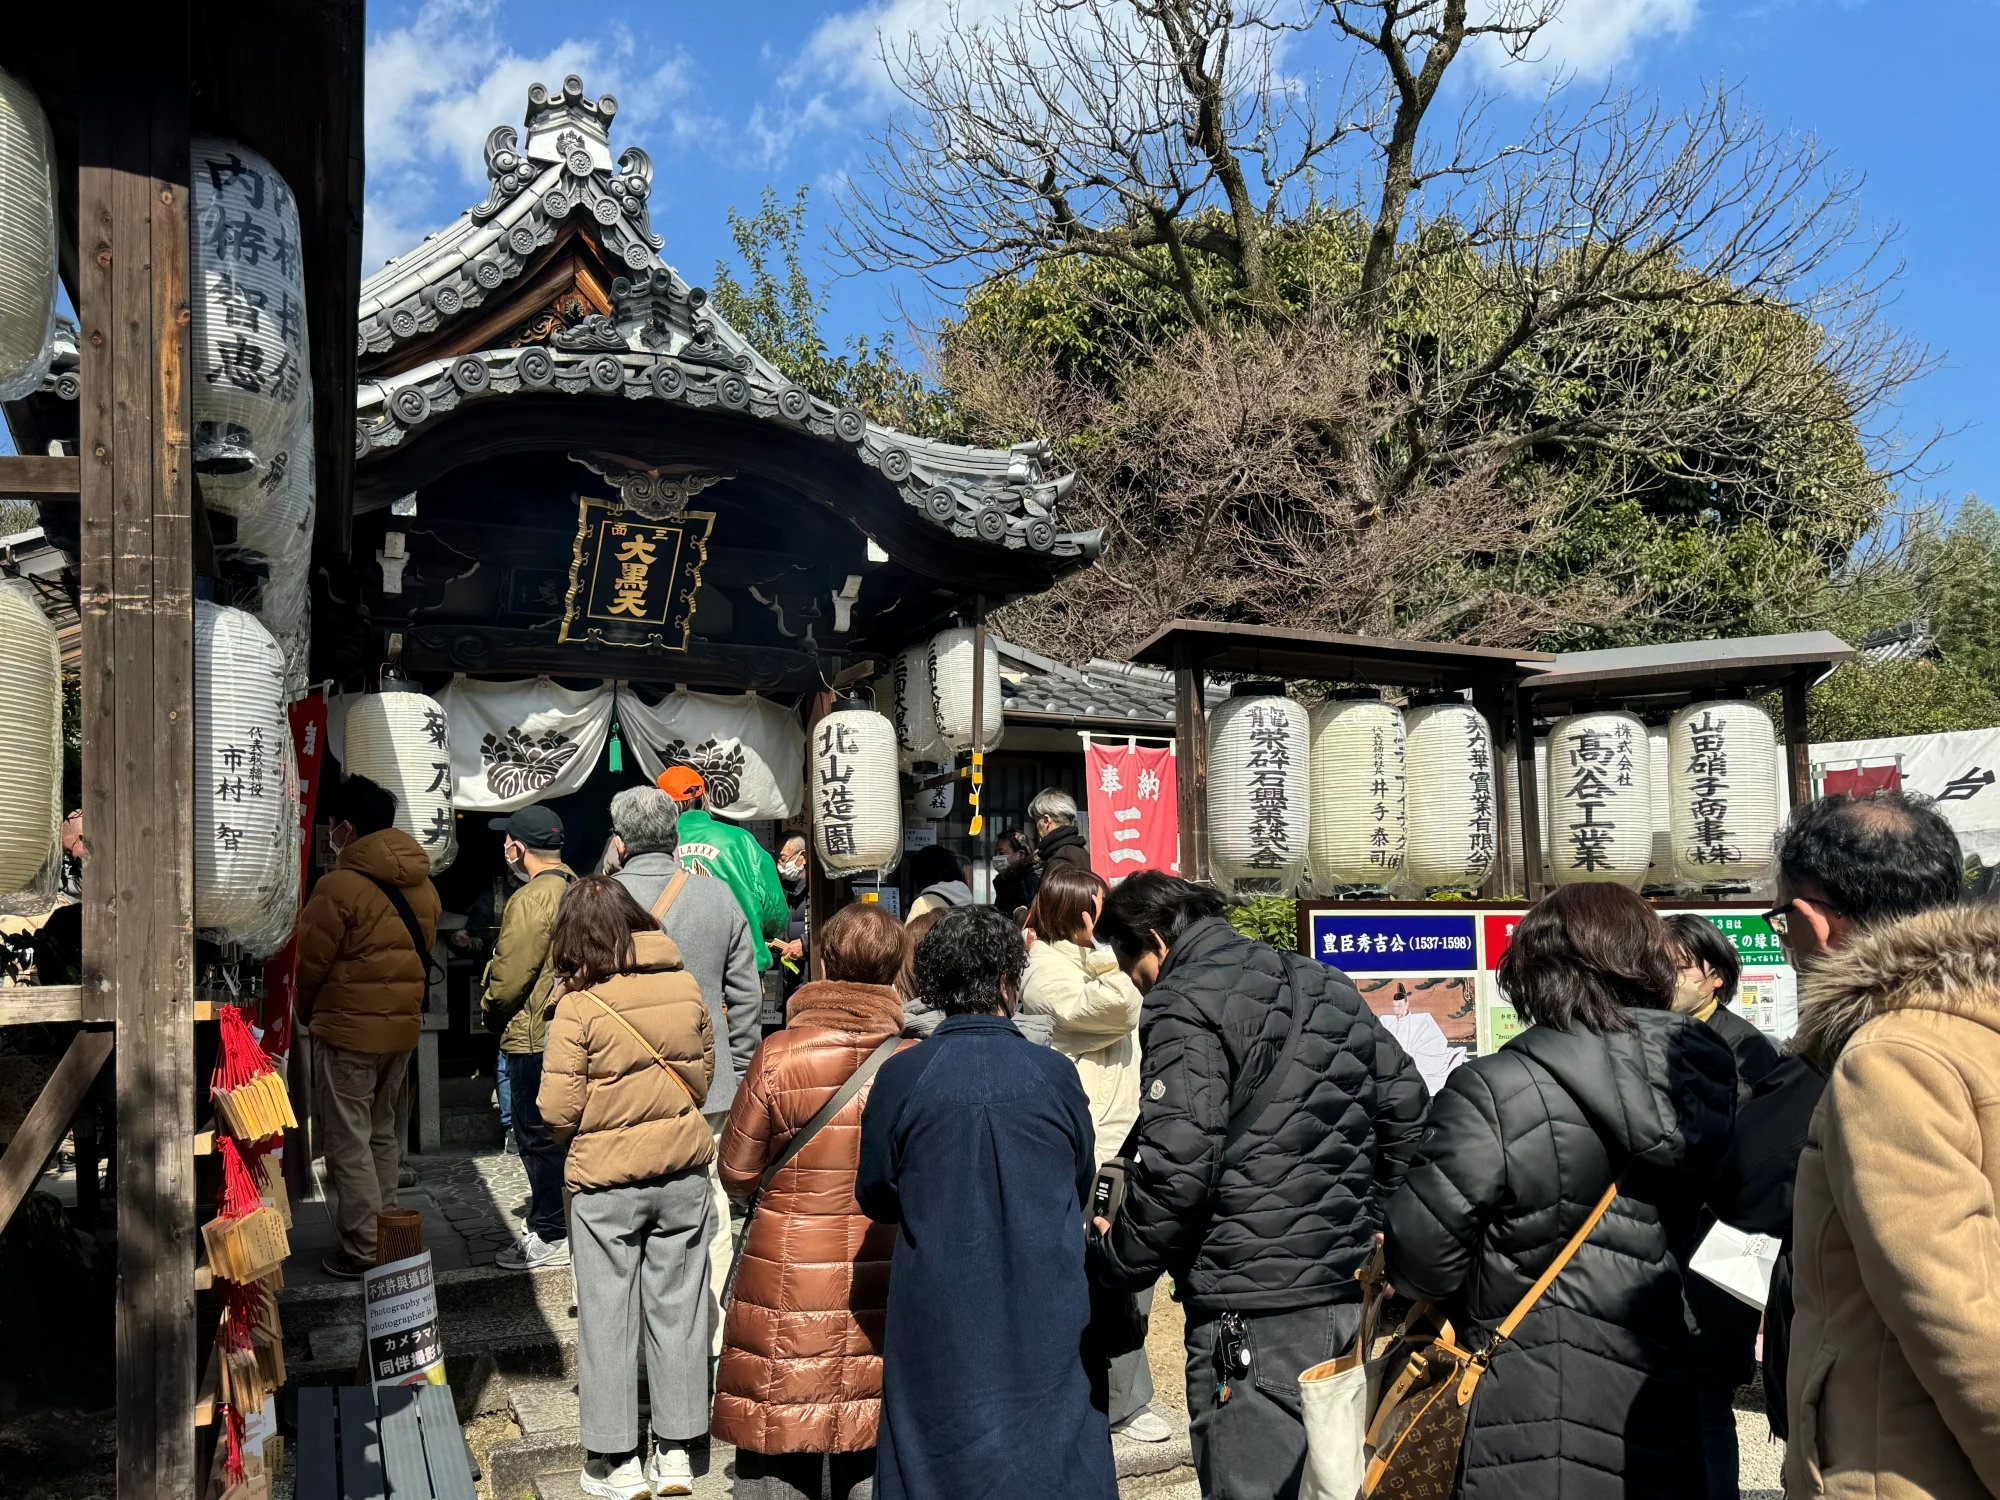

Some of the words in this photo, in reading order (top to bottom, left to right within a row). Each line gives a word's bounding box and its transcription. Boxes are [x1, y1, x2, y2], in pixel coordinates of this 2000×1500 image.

[247, 726, 264, 798] 代表取締役
[1614, 722, 1634, 787] 株式会社
[818, 722, 860, 856] 北山造園
[369, 1266, 433, 1300] 不允許與攝影
[370, 1298, 420, 1319] Photography
[371, 1309, 426, 1334] photographer
[379, 1343, 443, 1377] 同伴撮影
